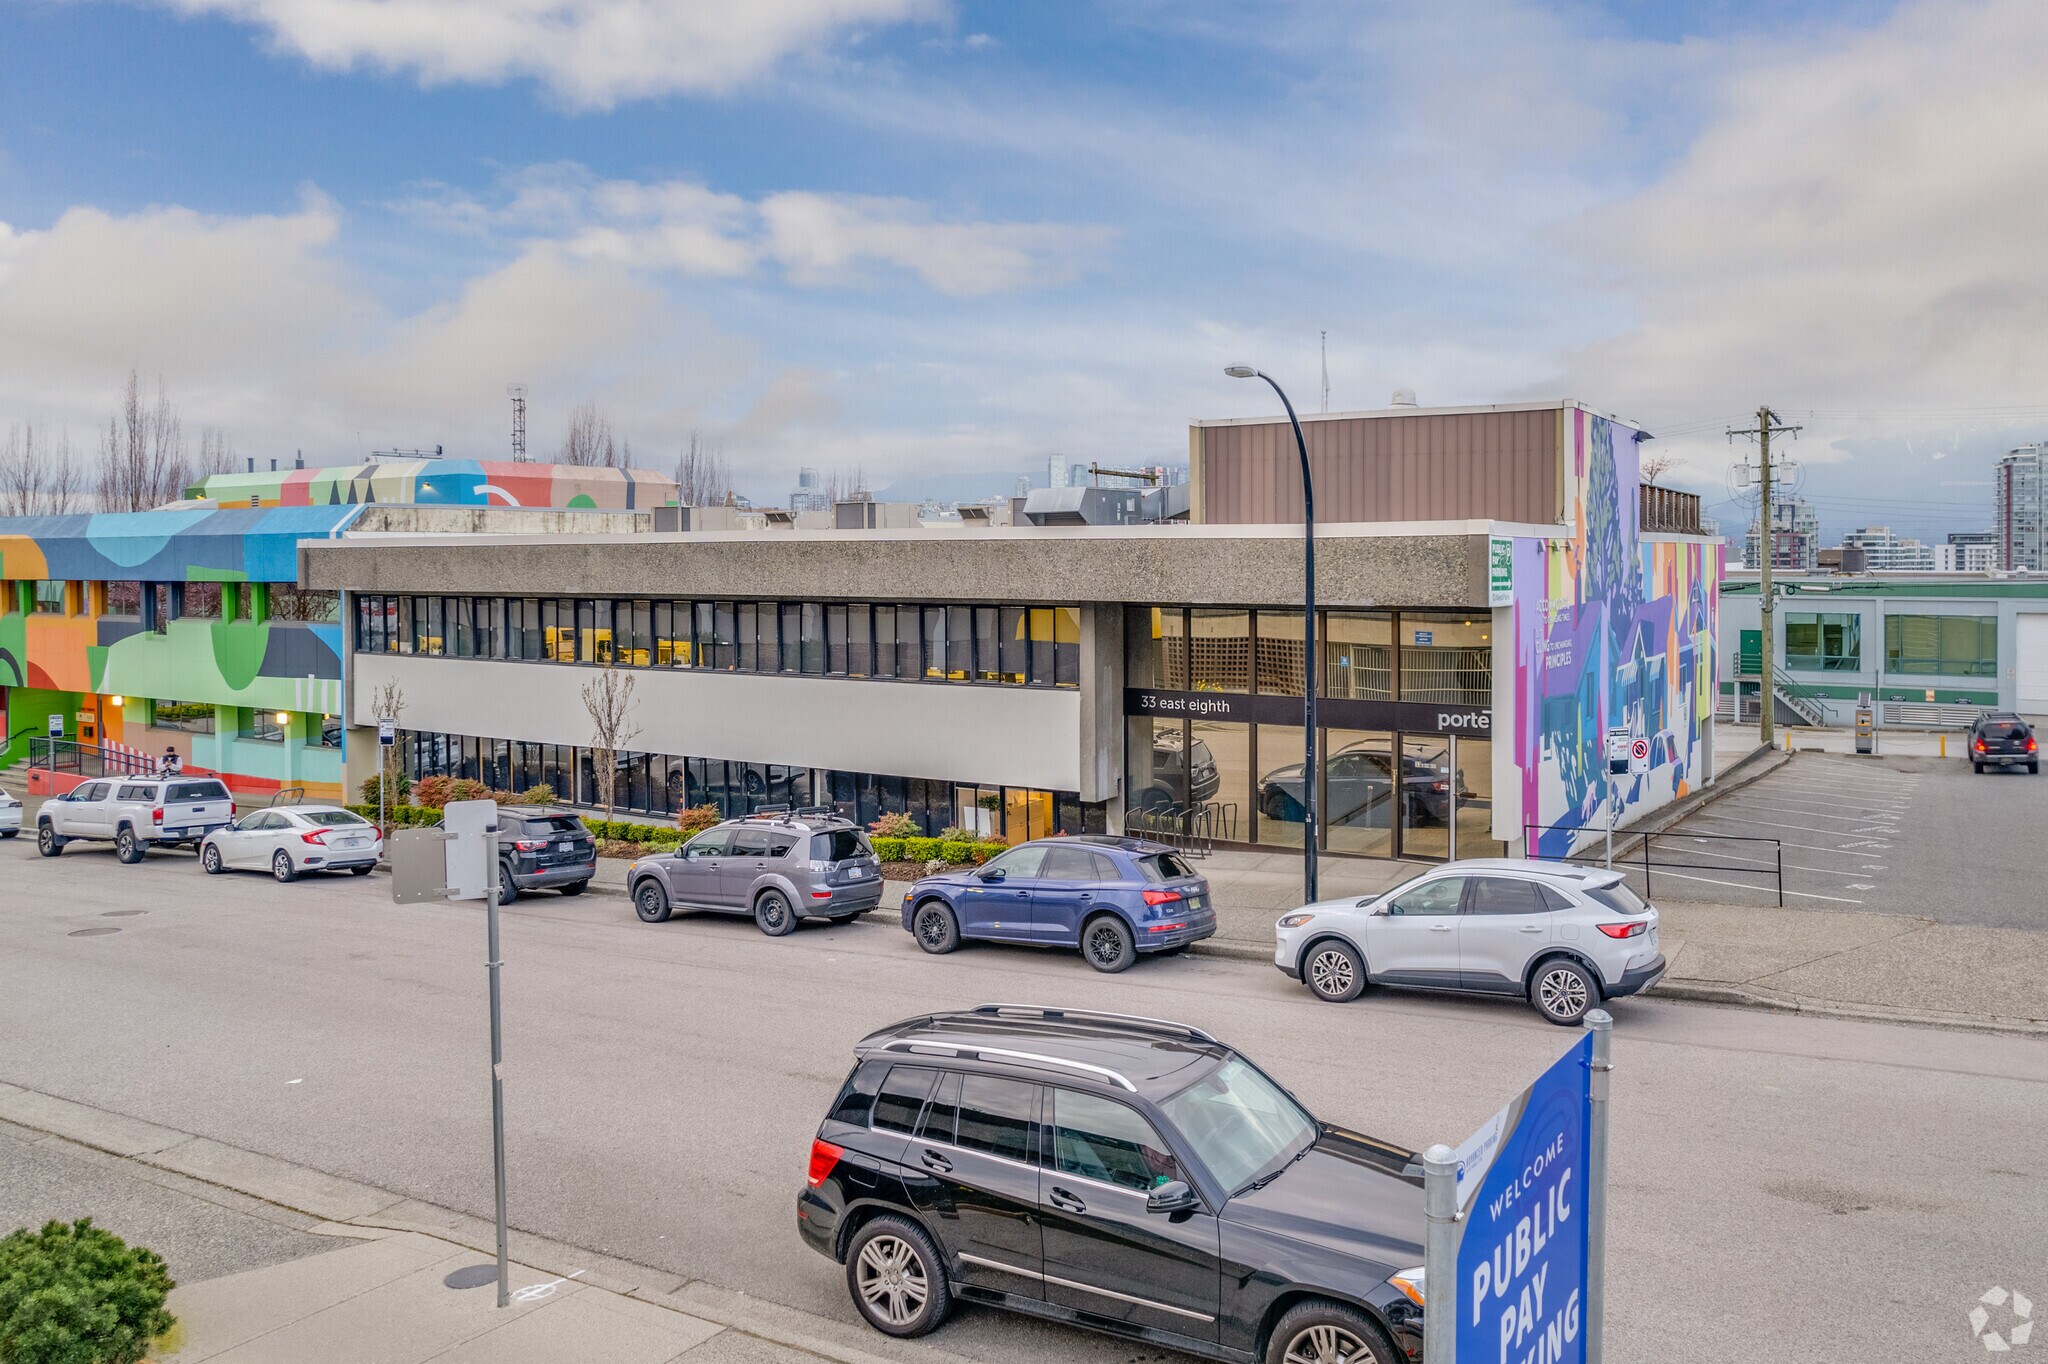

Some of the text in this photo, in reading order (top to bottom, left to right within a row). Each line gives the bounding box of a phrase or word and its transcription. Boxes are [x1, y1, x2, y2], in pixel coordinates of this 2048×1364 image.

[1492, 543, 1506, 555] PUBLIC
[1492, 555, 1501, 565] PAY
[1492, 567, 1508, 577] PARKING
[1545, 651, 1572, 671] PRINCIPLES
[1141, 695, 1230, 715] 33 east eighth
[1490, 1132, 1564, 1222] WELCOME
[1473, 1167, 1571, 1327] PUBLIC
[1500, 1261, 1548, 1364] PAY
